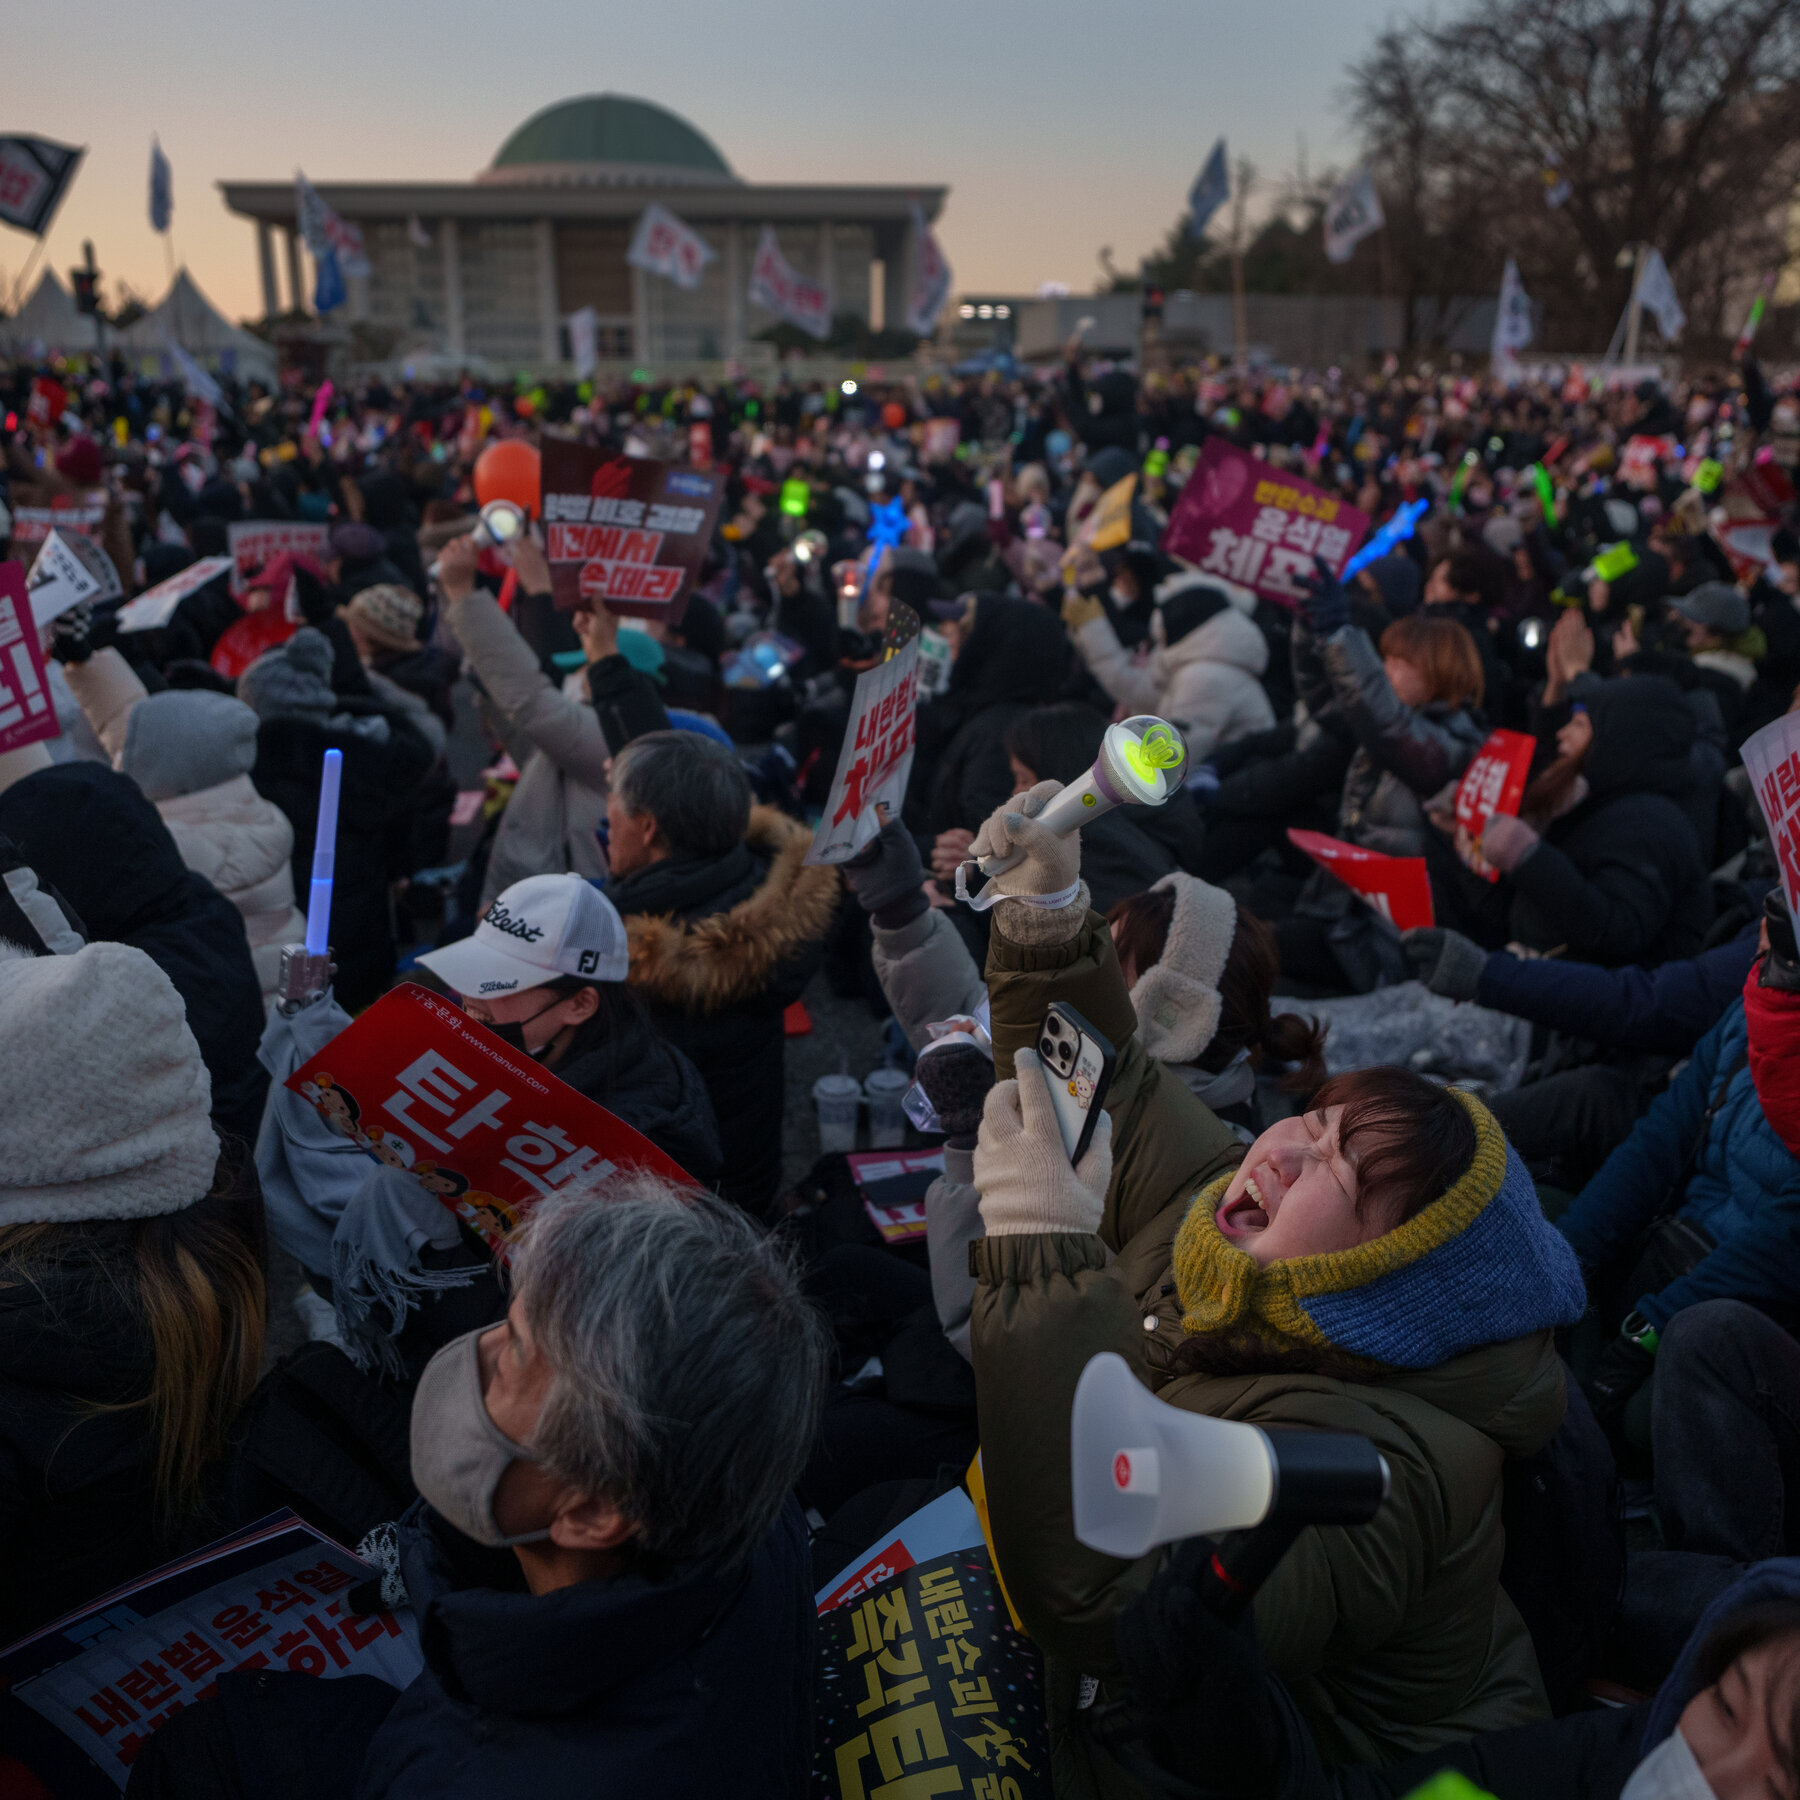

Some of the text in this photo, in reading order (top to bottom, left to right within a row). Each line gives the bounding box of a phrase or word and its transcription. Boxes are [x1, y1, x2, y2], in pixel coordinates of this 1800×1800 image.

[1251, 507, 1353, 563] 윤석열
[410, 988, 552, 1097] 나눔문화 www.nanum.com
[478, 979, 520, 994] Titleist
[381, 1048, 618, 1200] 탄핵
[74, 1630, 226, 1738] 내란범
[211, 1560, 358, 1650] 윤석열
[918, 1566, 1000, 1718] 내란수괴
